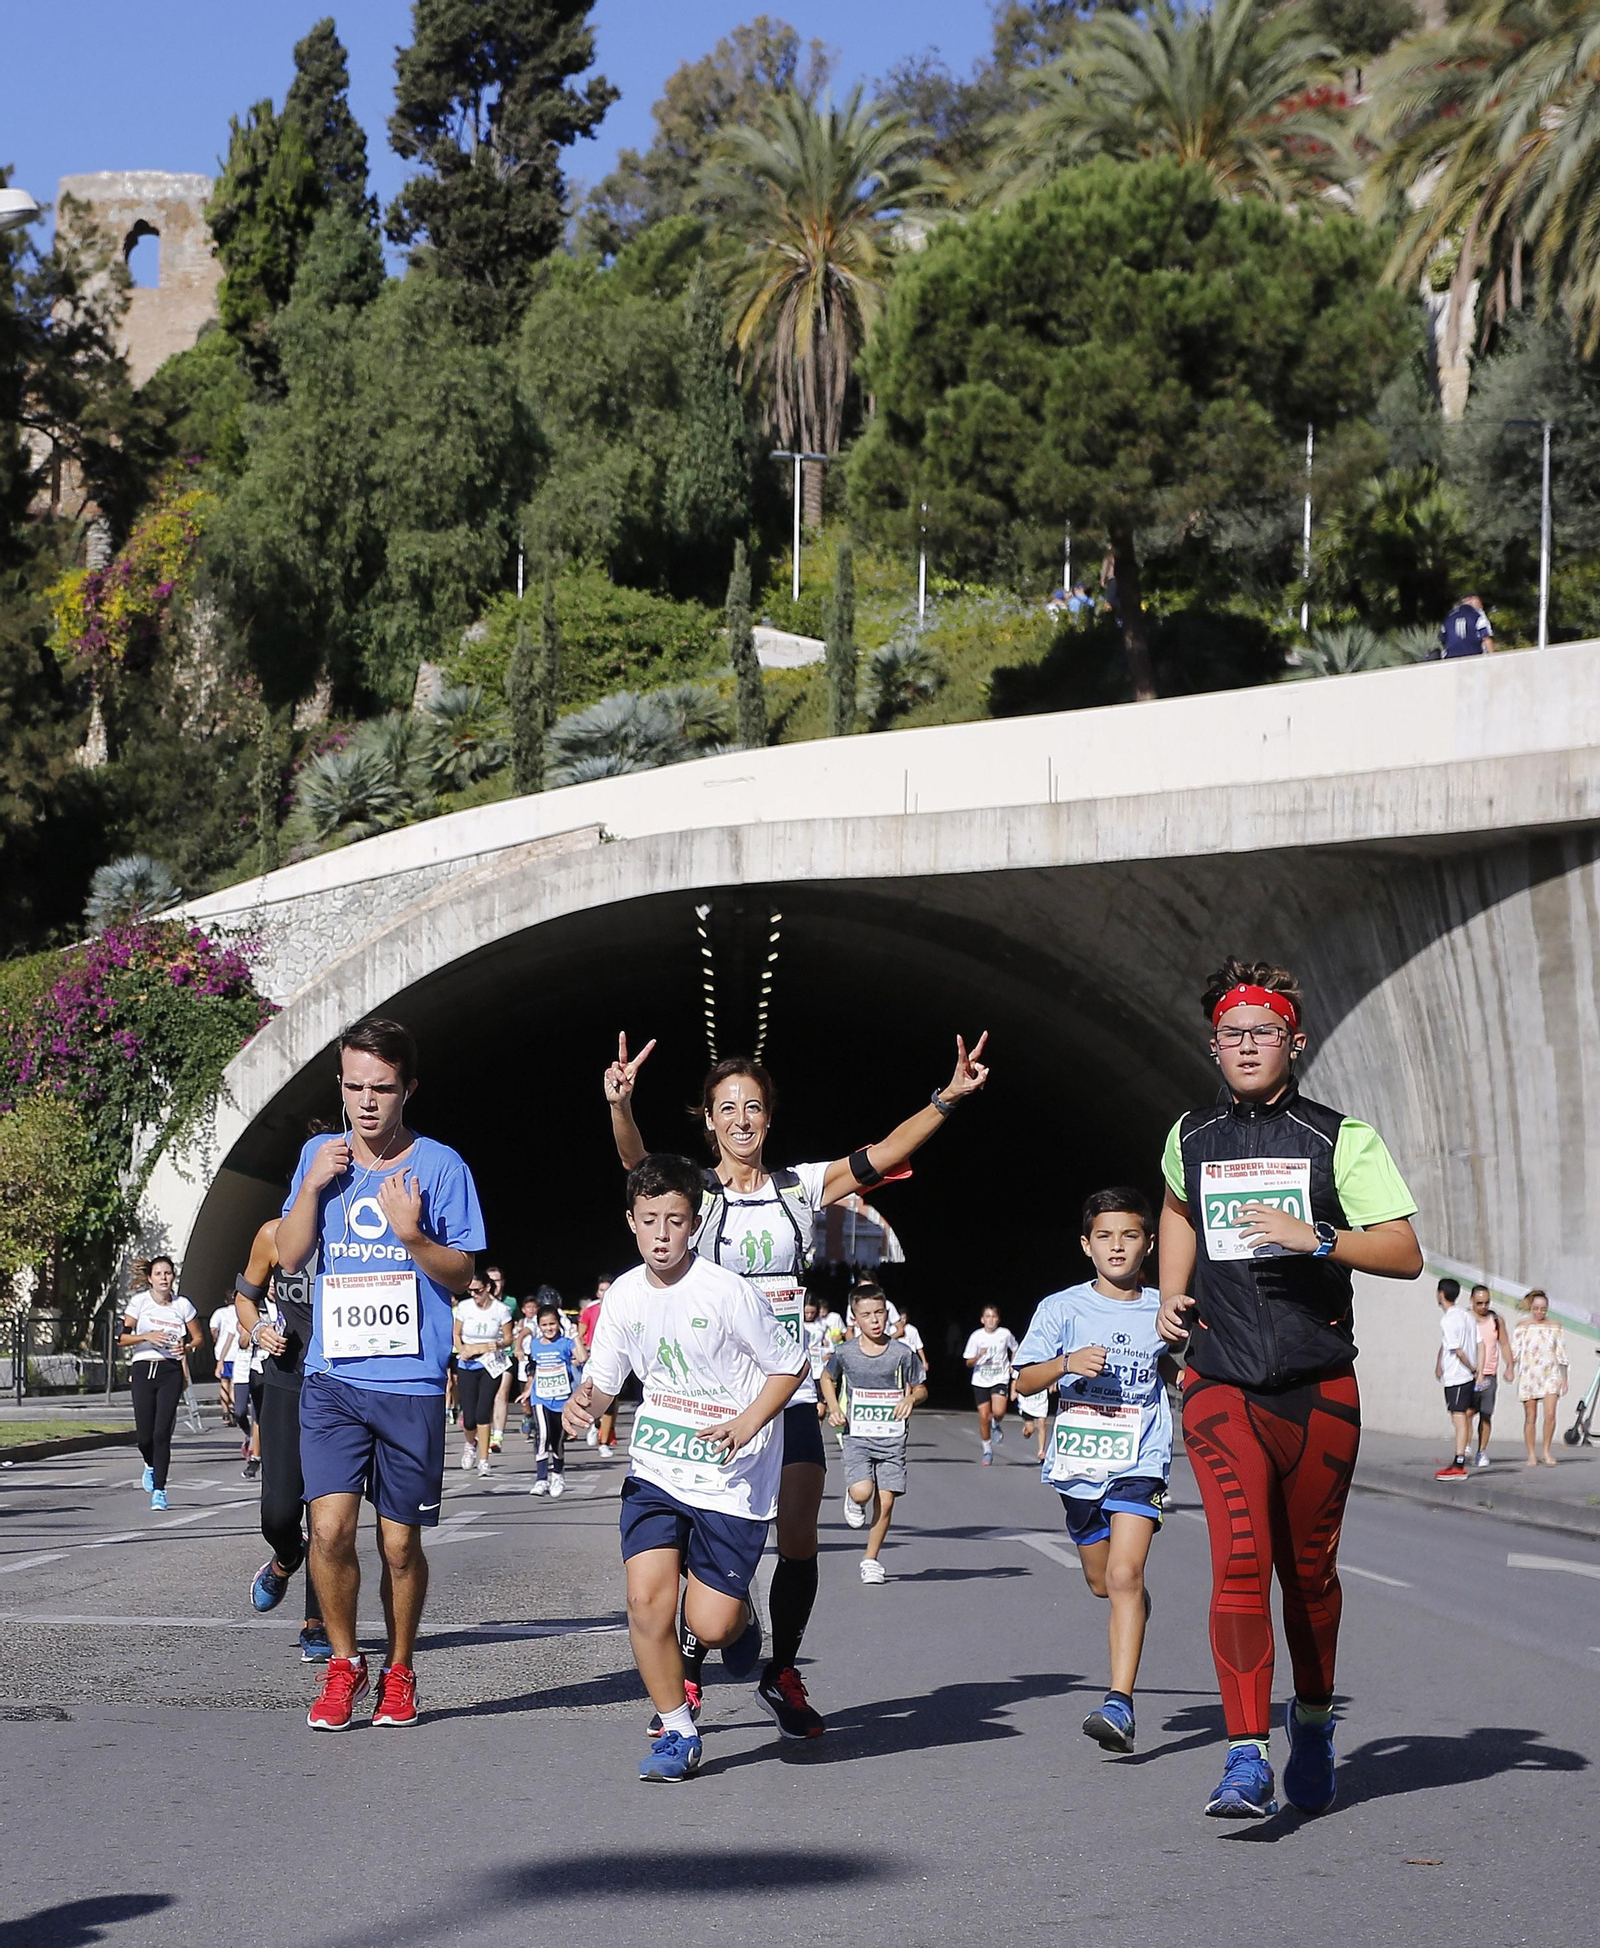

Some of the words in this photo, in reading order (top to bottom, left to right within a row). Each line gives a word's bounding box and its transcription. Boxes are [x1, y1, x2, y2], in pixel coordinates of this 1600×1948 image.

[1224, 1162, 1265, 1172] CARRERA
[326, 1277, 341, 1289] 41
[341, 1275, 379, 1284] CARRERA
[380, 1273, 414, 1282] URBANA
[332, 1303, 410, 1328] 18006
[1123, 1346, 1150, 1359] Hotels
[538, 1375, 566, 1387] 20526
[1103, 1361, 1149, 1386] erja
[651, 1393, 662, 1406] 41
[662, 1394, 699, 1409] CARRERA
[701, 1403, 738, 1416] URBANA
[855, 1407, 893, 1422] 2037
[1057, 1430, 1129, 1460] 22583
